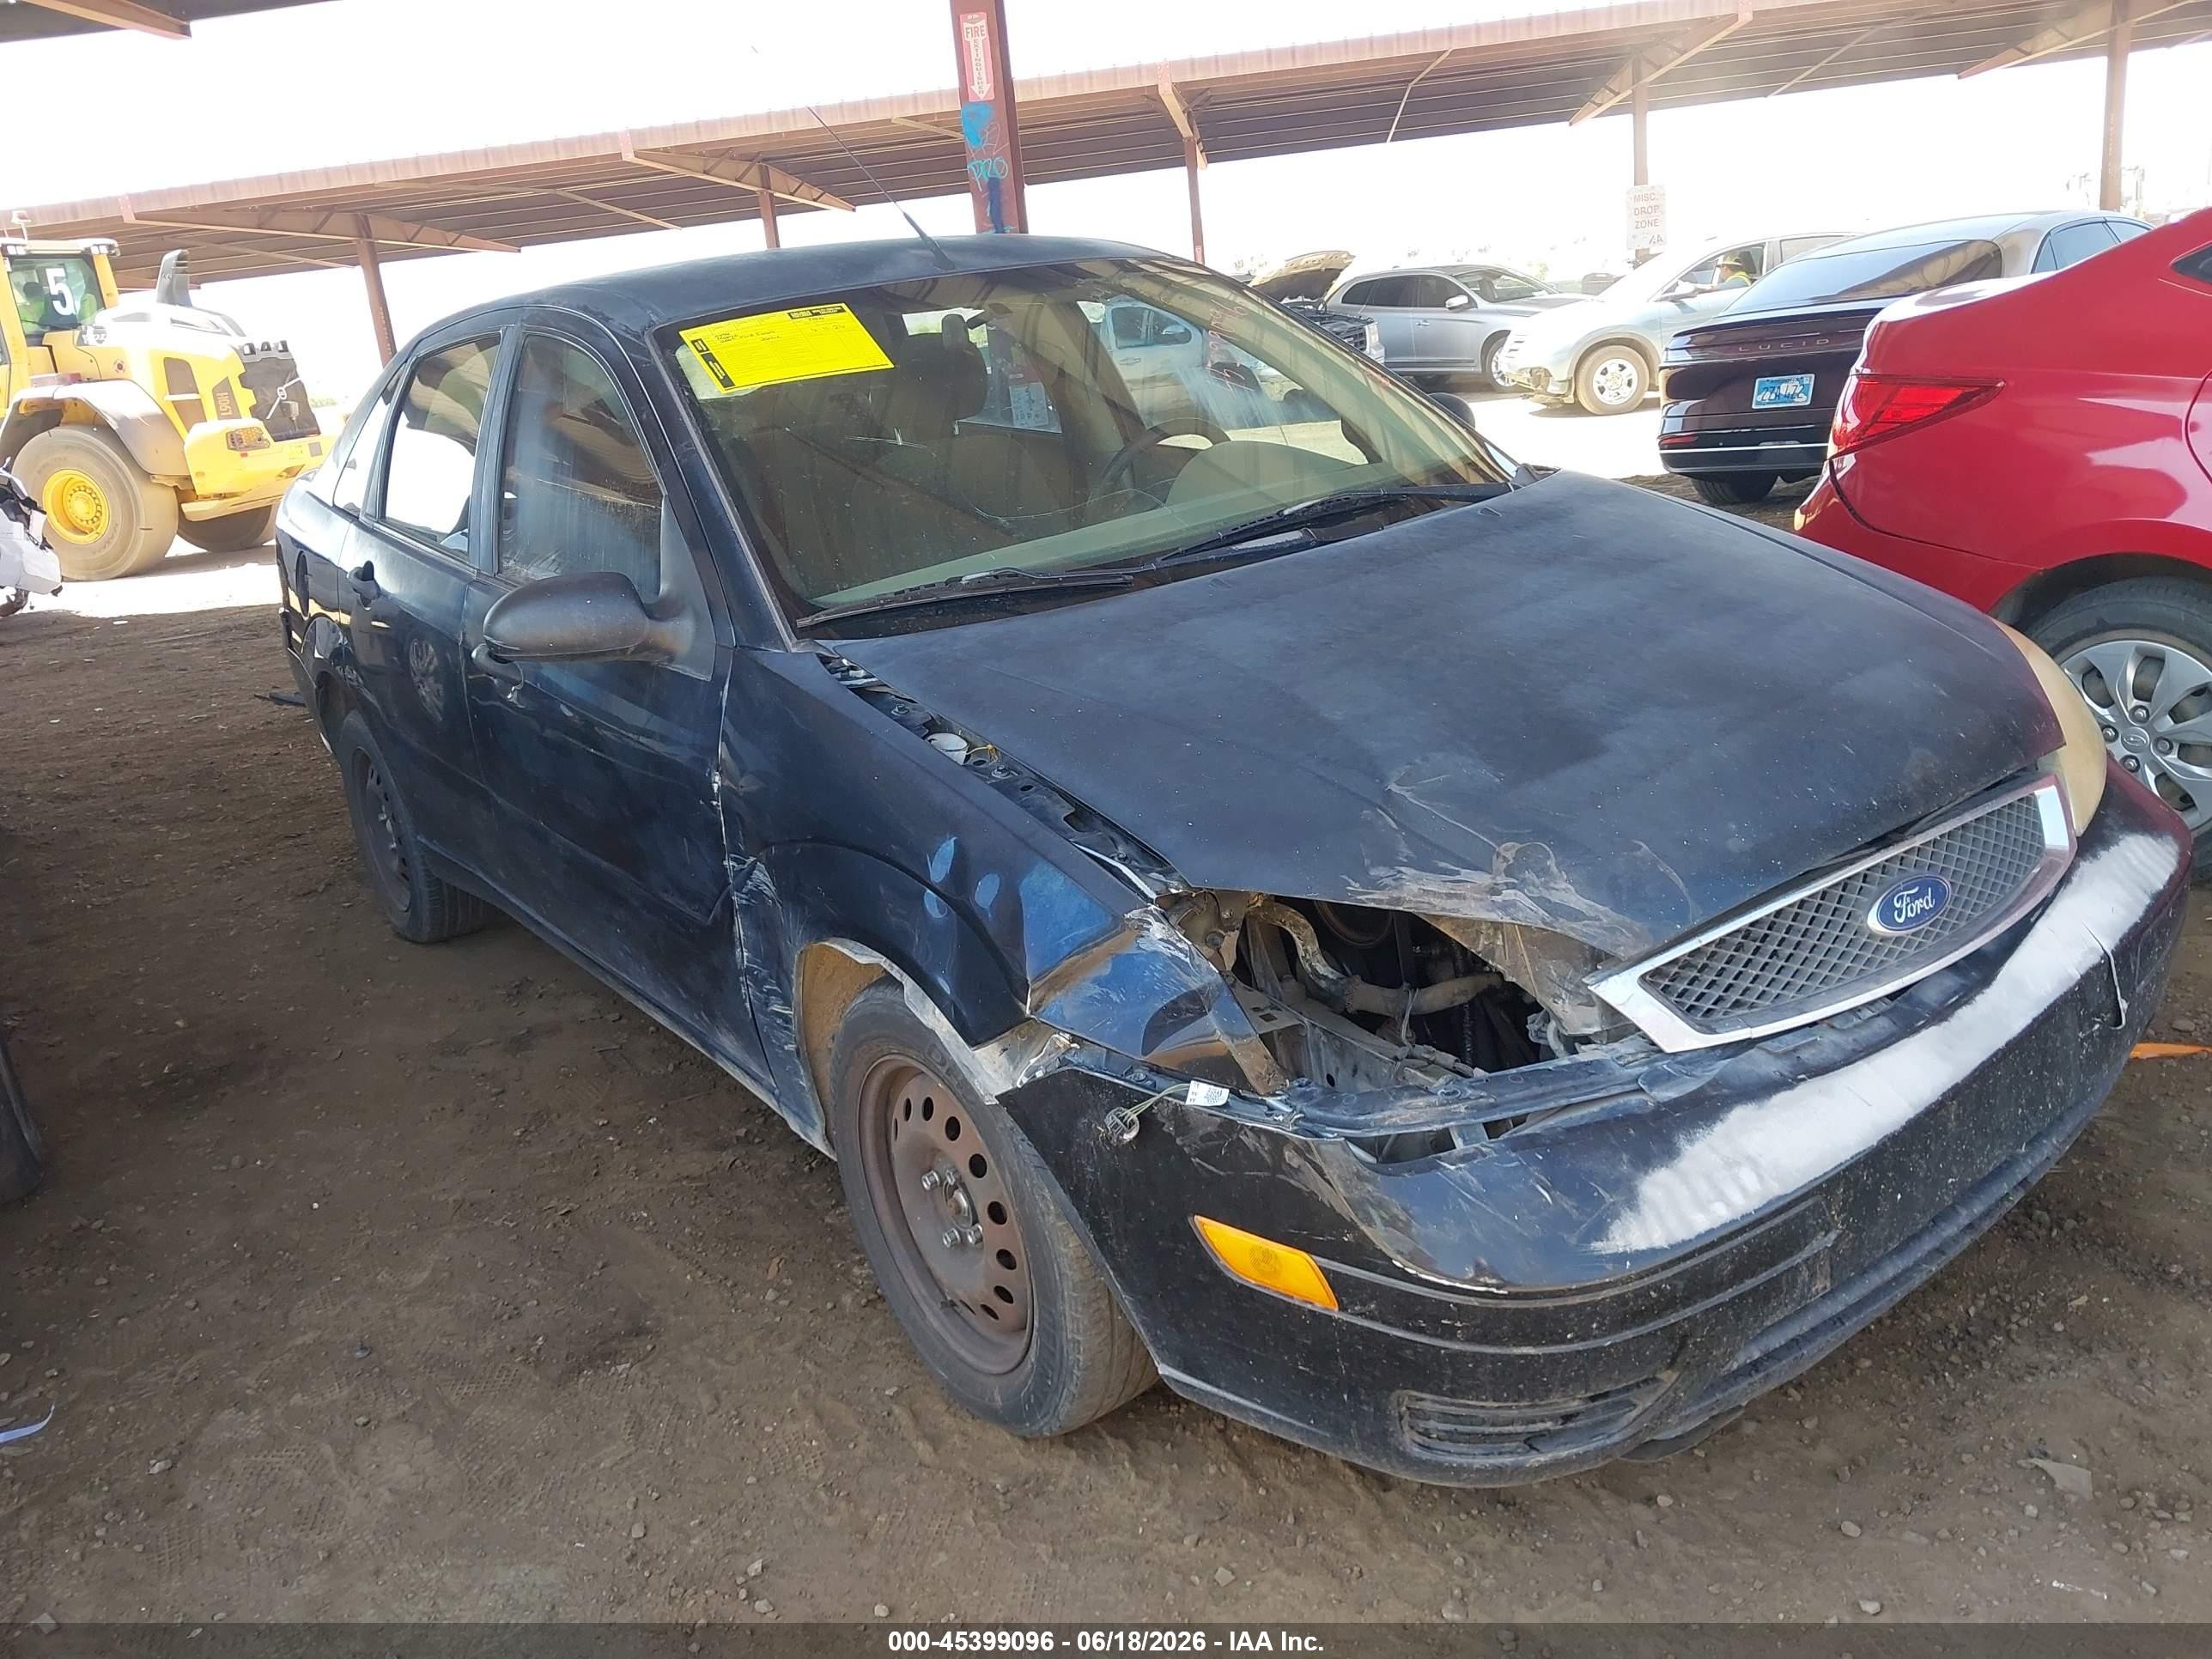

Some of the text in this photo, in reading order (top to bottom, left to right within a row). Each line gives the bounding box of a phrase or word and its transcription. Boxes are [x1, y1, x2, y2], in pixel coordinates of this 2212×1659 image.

[964, 25, 986, 39] FIRE
[973, 39, 985, 94] EXTINGUISHER
[1633, 191, 1656, 203] MISC
[1634, 205, 1660, 216] DROP
[1634, 218, 1661, 229] ZONE
[46, 267, 76, 316] 5
[1738, 338, 1830, 352] LUCID
[1893, 886, 1936, 923] Ford
